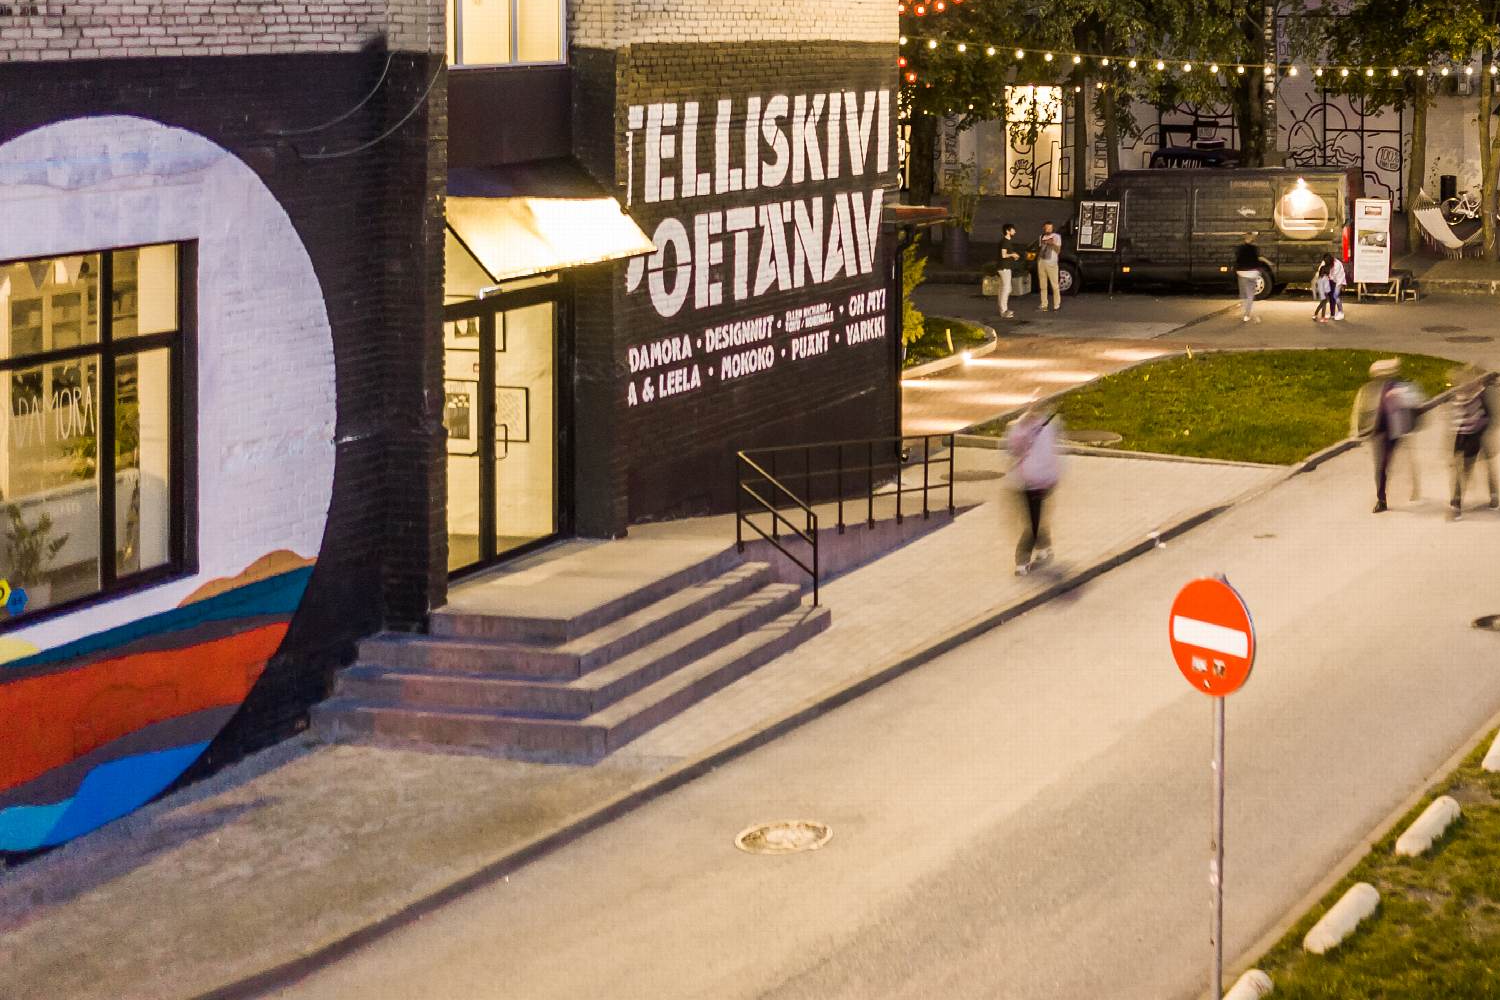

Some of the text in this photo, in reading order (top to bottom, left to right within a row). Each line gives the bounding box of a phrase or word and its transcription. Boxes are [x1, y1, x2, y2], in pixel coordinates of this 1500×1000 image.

[626, 189, 884, 318] OETÄNAV
[628, 334, 692, 374] DAMORA
[705, 314, 775, 353] DESIGNNUT
[849, 294, 865, 317] OH
[659, 364, 702, 398] LEELA
[721, 345, 775, 381] MOKOKO
[845, 316, 886, 346] VARKKI
